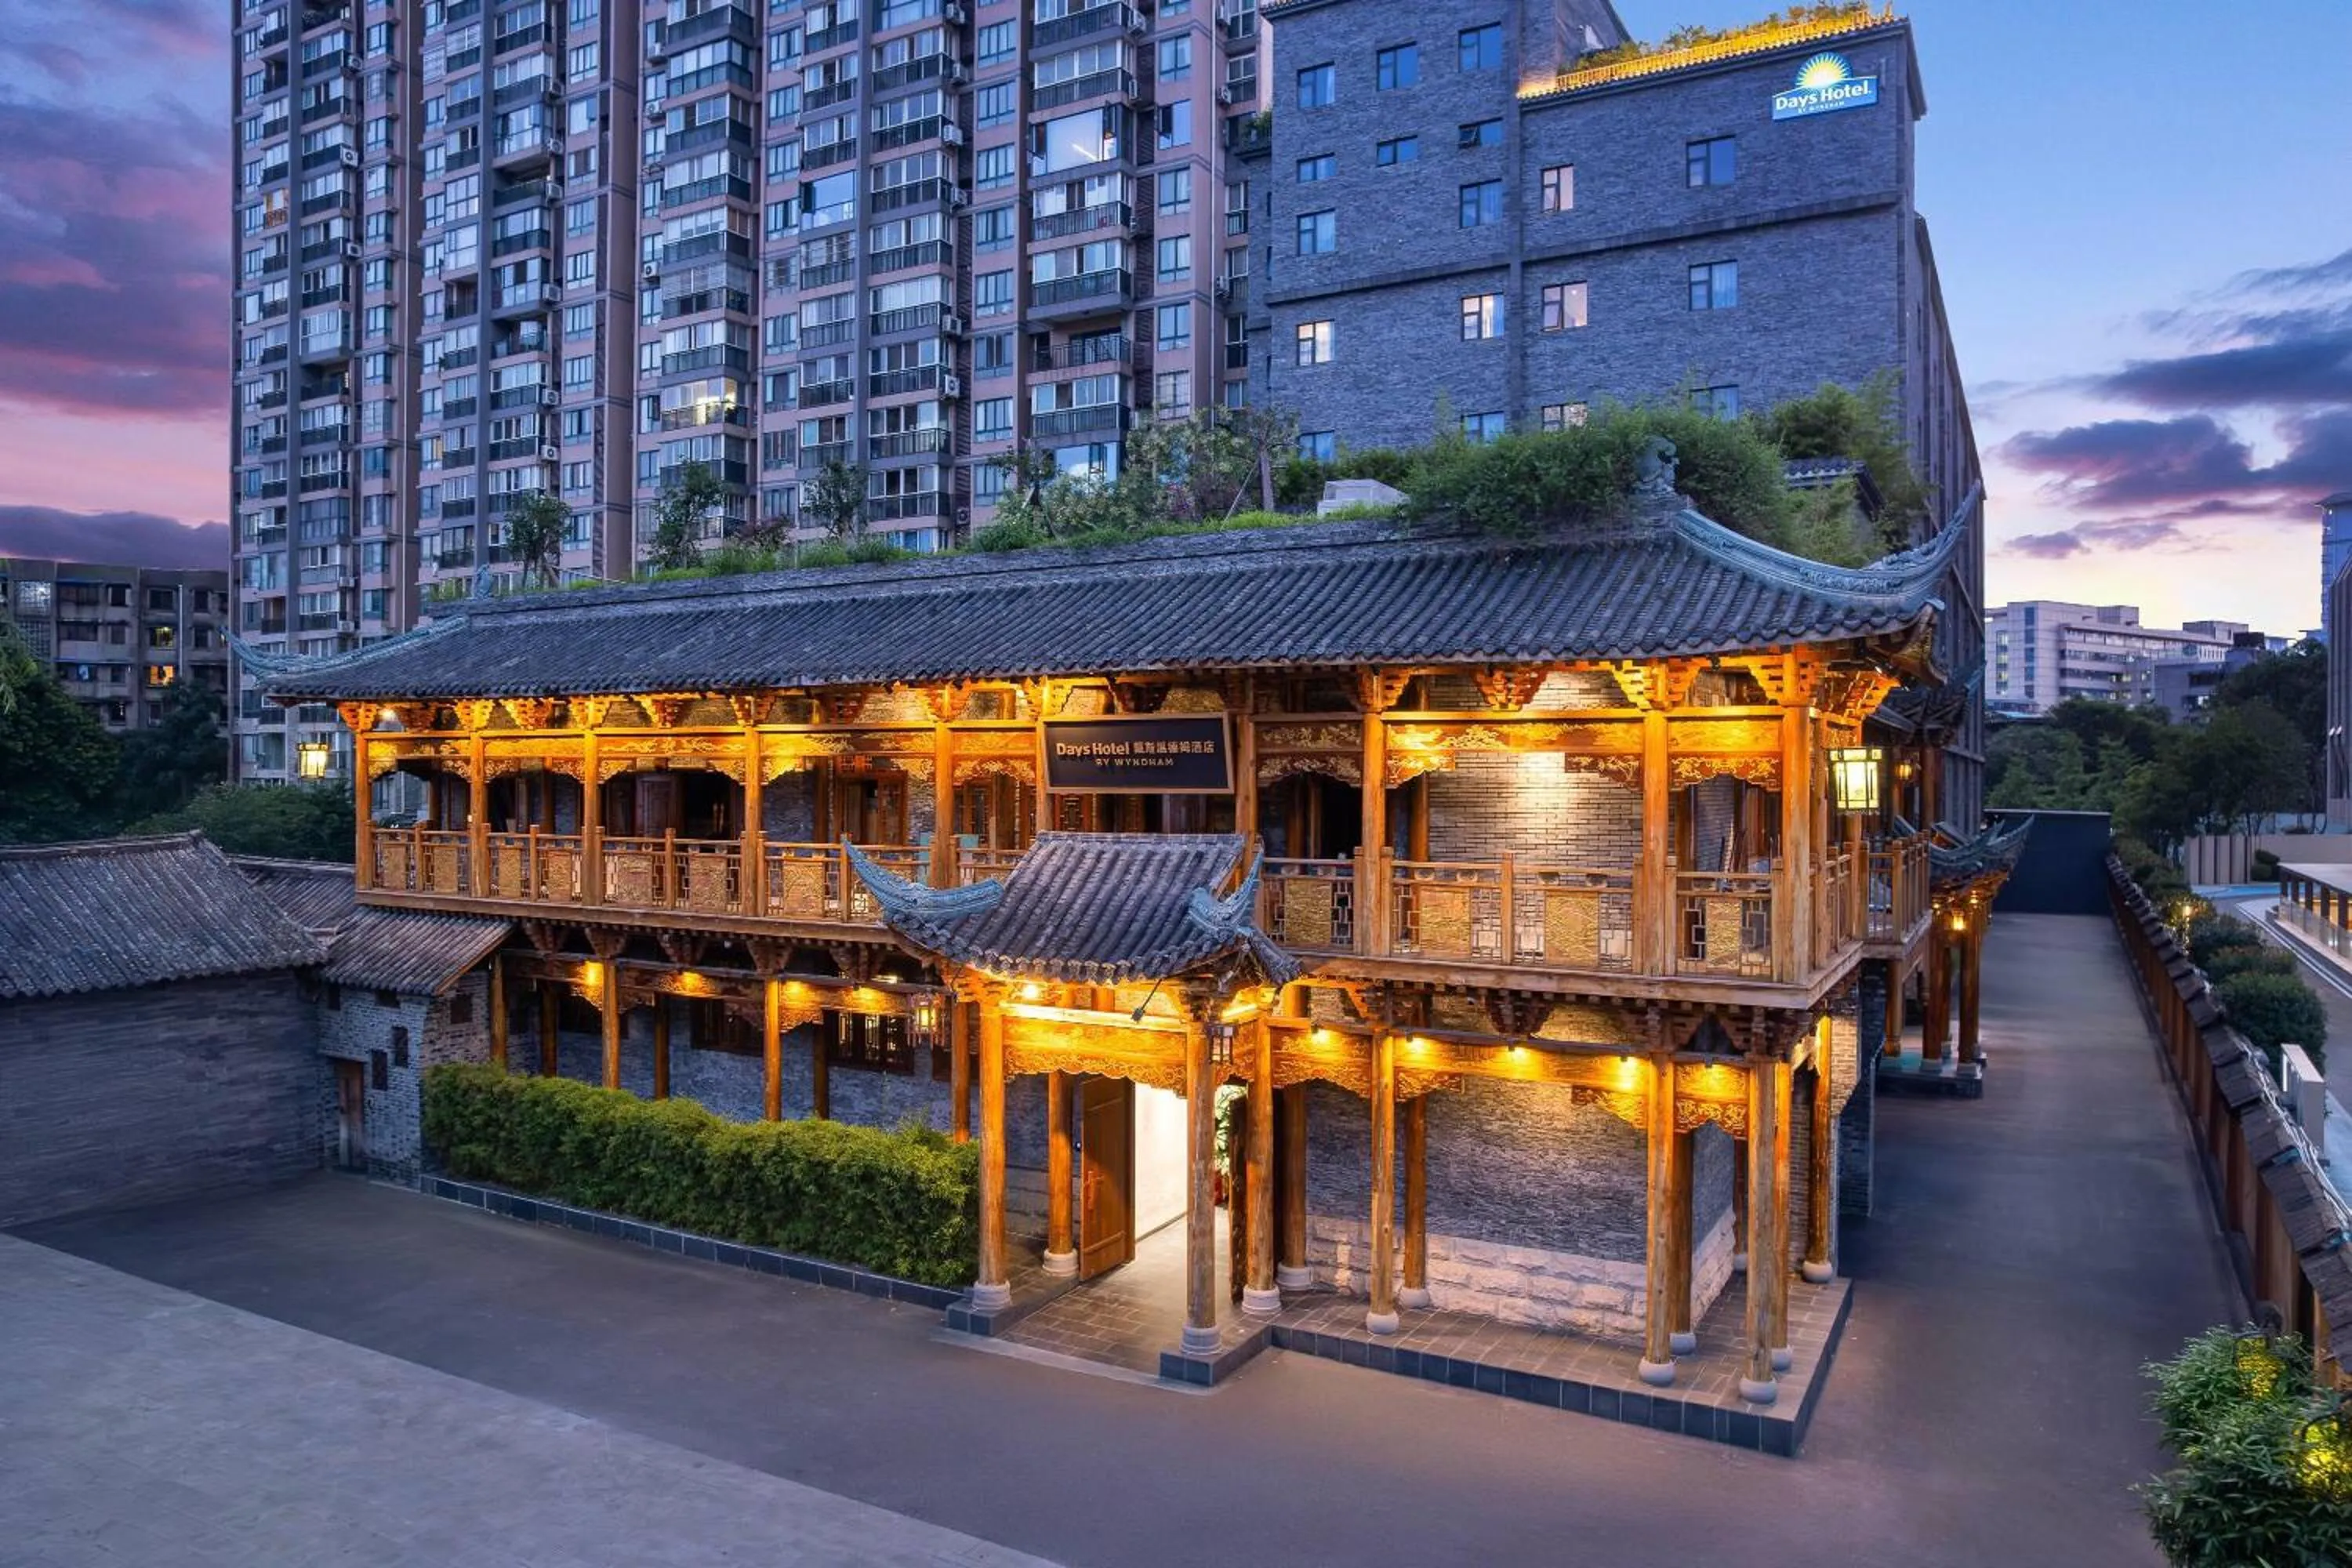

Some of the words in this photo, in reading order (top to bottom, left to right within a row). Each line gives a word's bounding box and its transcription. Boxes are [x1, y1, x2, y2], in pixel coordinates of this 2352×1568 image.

[1775, 93, 1817, 110] Days
[1820, 80, 1868, 101] Hotel
[1056, 742, 1091, 757] Days
[1092, 742, 1130, 755] Hotel
[1114, 757, 1174, 766] WYNDHAM
